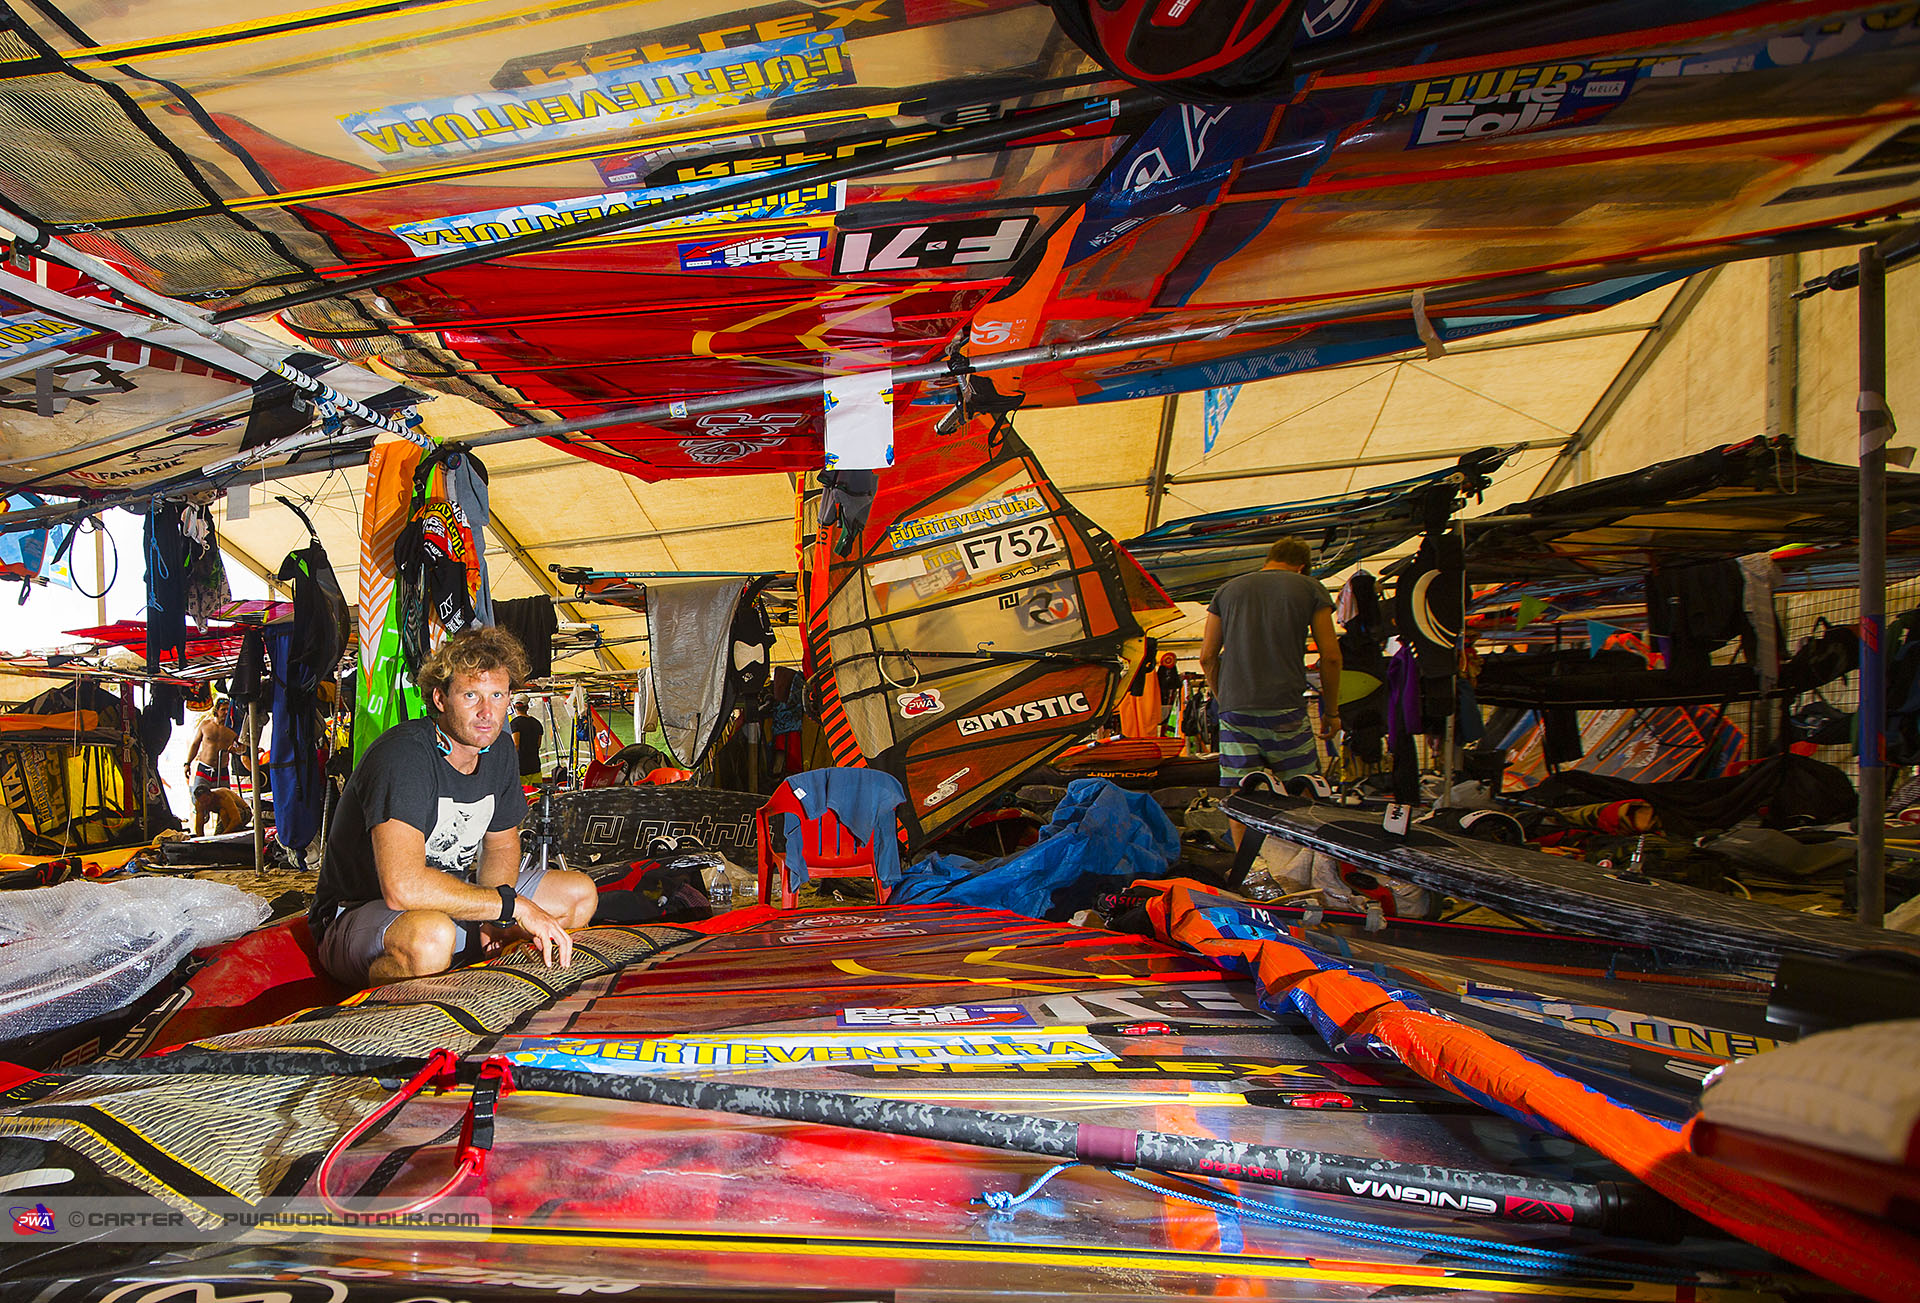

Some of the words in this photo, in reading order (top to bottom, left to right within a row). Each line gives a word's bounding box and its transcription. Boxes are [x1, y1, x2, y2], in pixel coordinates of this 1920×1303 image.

[354, 44, 847, 154] FUERTEVENTURA
[724, 236, 820, 258] Egli
[724, 249, 819, 267] René
[1201, 348, 1319, 385] VAPOR
[98, 458, 184, 480] FANATIC
[890, 497, 1042, 543] FUERTEVENTURA
[962, 525, 1056, 570] F752
[908, 699, 935, 711] PWA
[983, 692, 1090, 731] MYSTIC
[843, 1005, 968, 1016] René
[844, 1011, 971, 1025] Egli
[1346, 1175, 1498, 1215] ENIGMA
